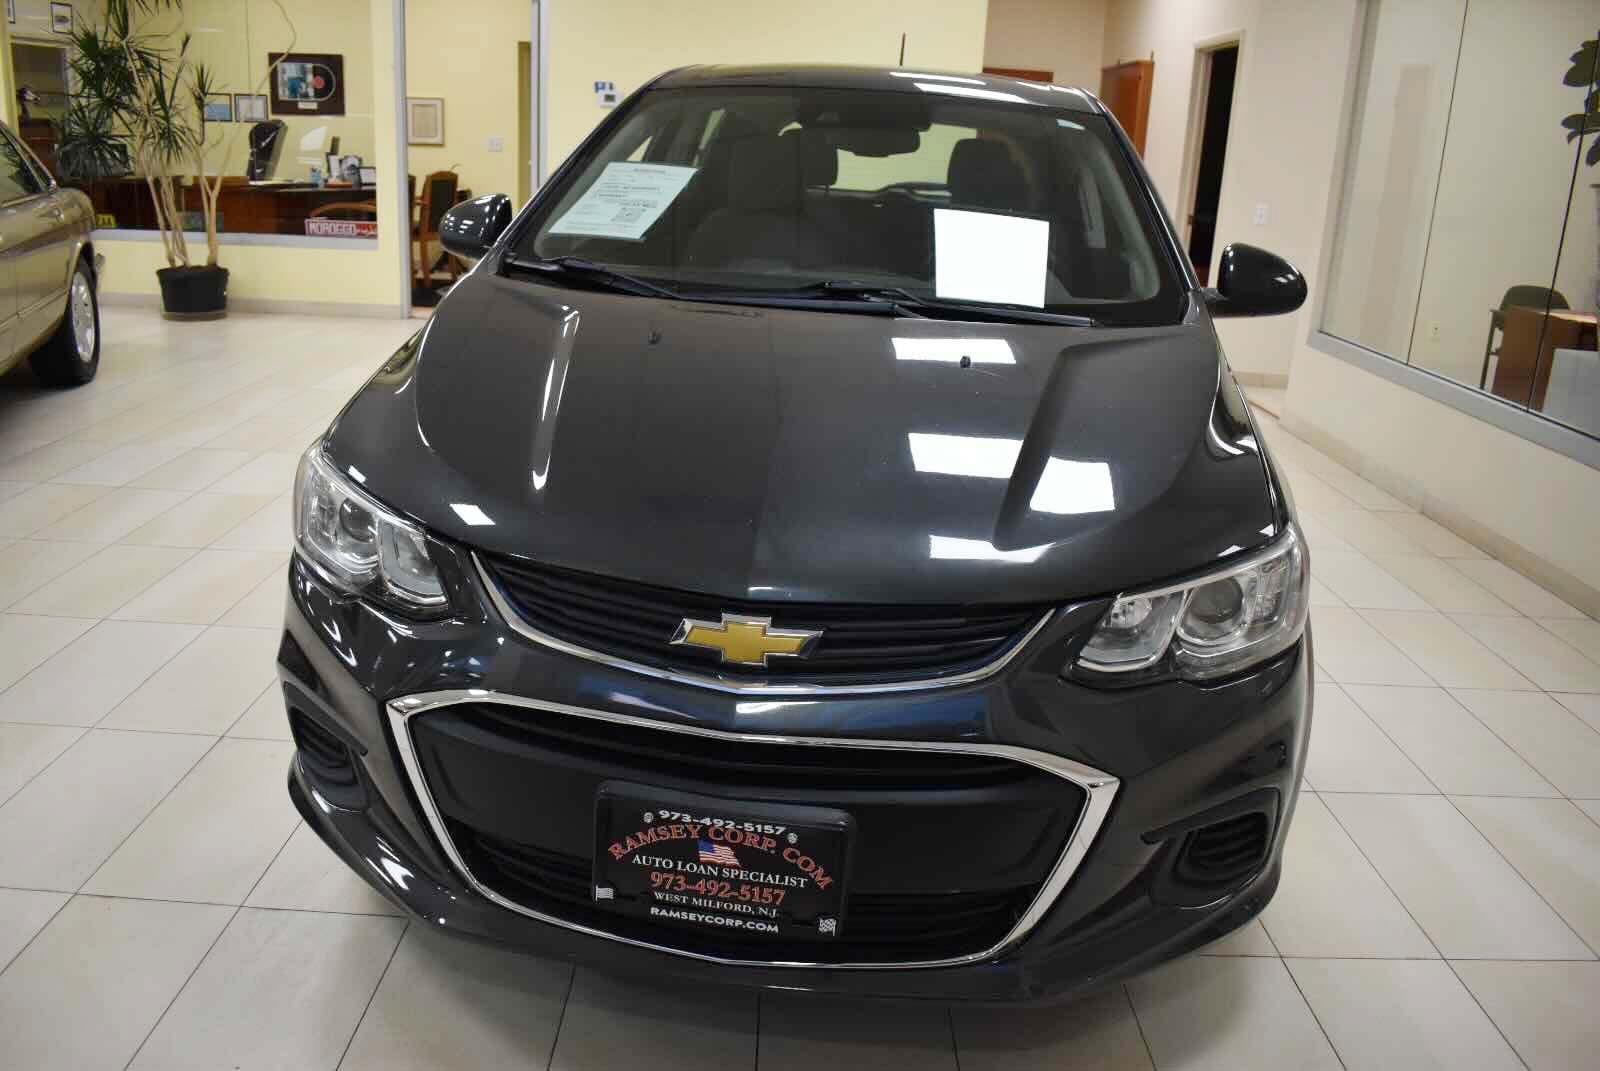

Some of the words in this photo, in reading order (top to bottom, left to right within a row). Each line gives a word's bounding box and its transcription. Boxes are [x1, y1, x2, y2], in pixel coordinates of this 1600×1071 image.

[658, 809, 787, 835] 973-492-5157
[607, 823, 704, 861] RAMSEY
[782, 846, 833, 889] COM
[632, 853, 674, 869] AUTO
[677, 860, 719, 877] LOAN
[721, 867, 809, 888] SPECIALIST
[650, 871, 786, 905] 973-492-5157
[654, 891, 689, 904] WEST
[691, 897, 756, 915] MILFORD,
[649, 906, 779, 934] RAMSEYCORP.COM
